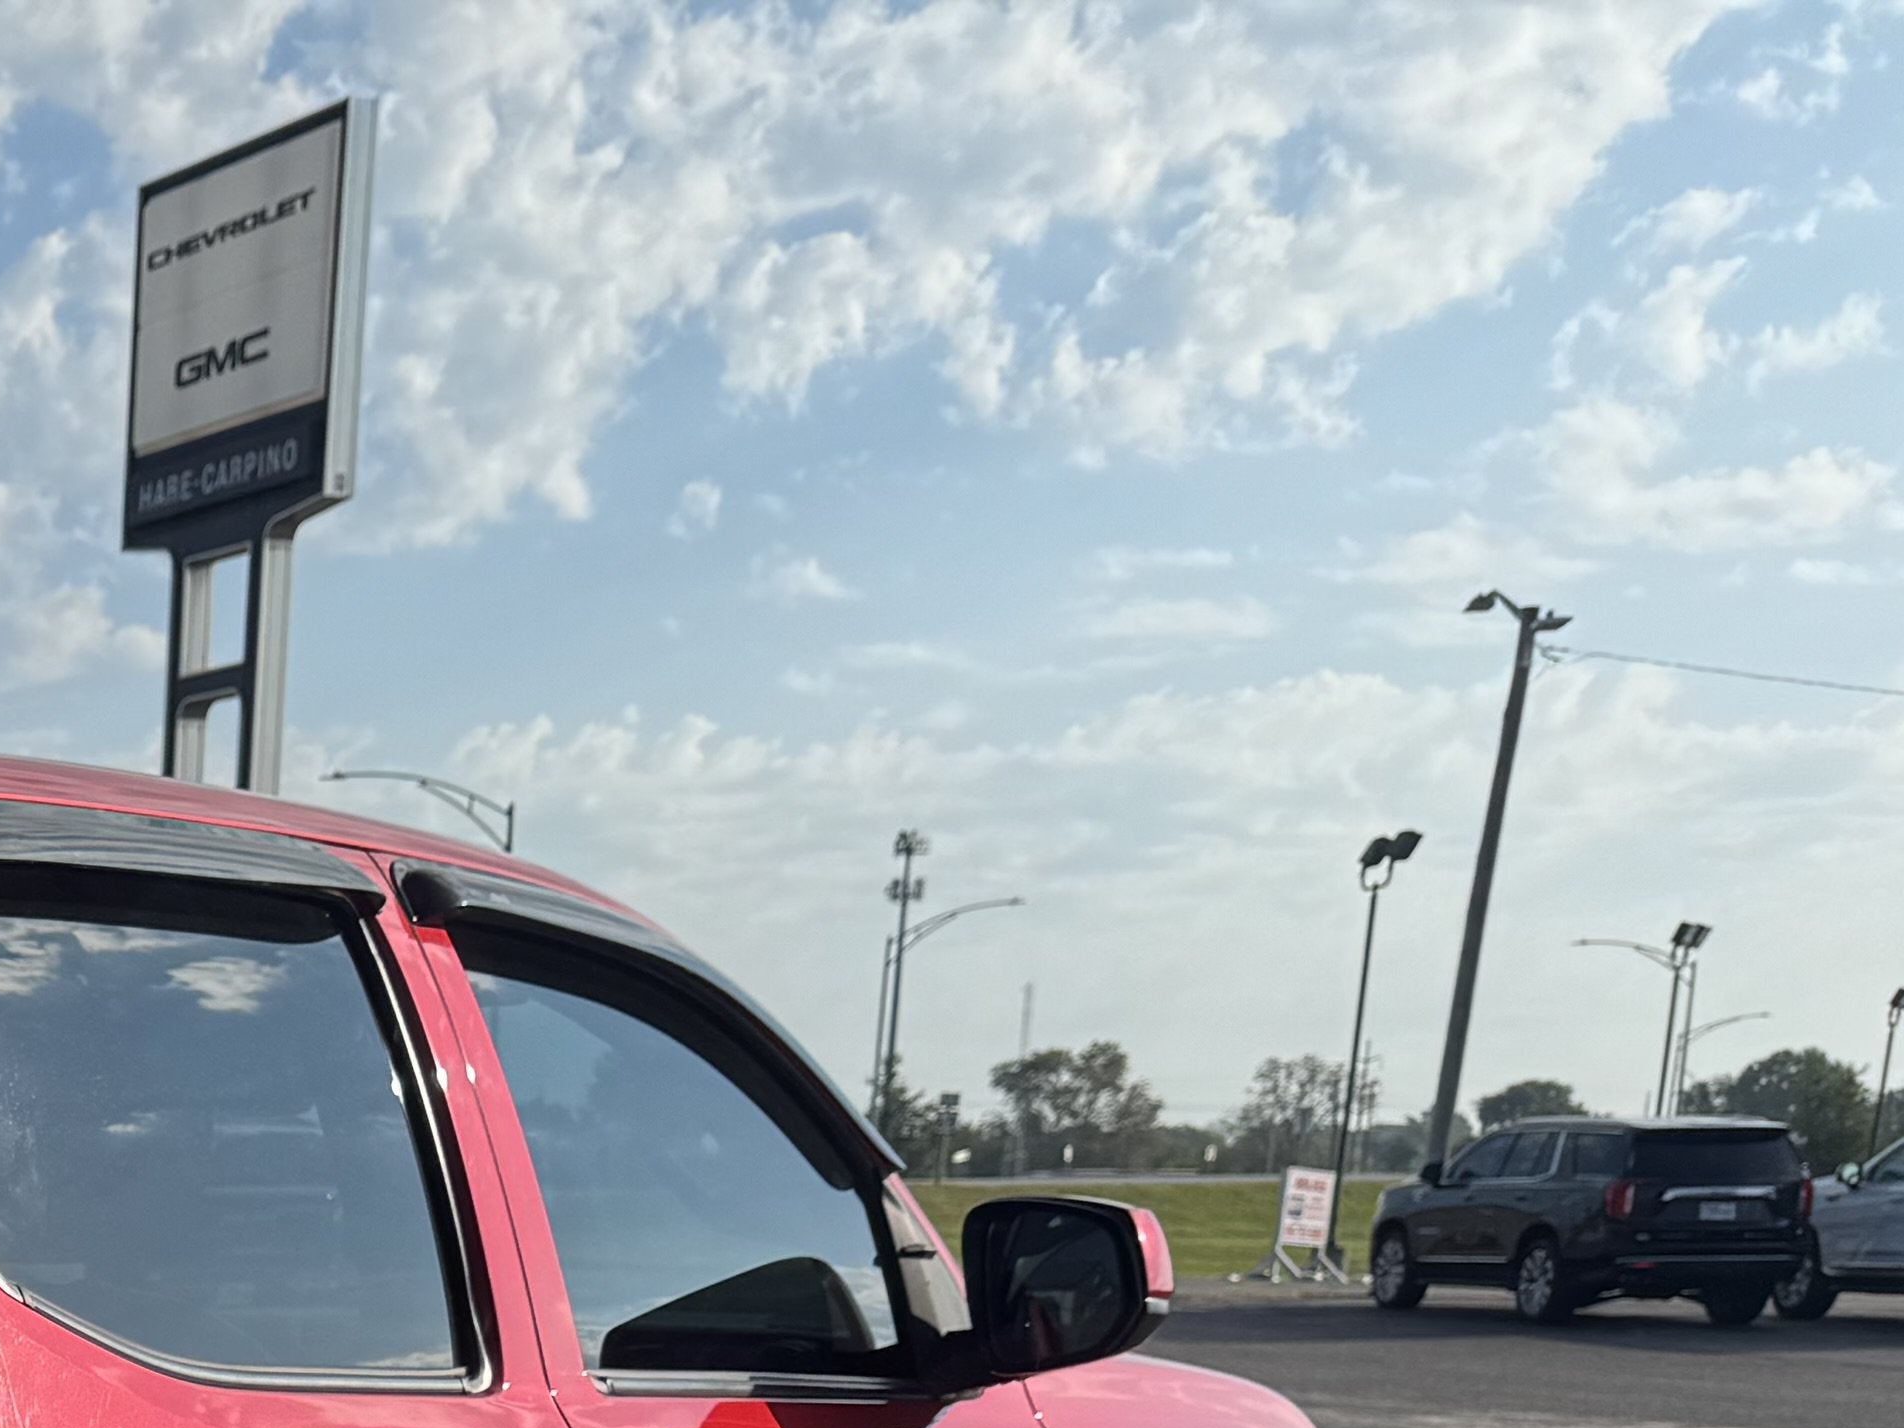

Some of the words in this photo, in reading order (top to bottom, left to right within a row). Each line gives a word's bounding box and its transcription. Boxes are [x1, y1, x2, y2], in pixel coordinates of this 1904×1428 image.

[147, 187, 316, 272] CHEVROLET
[174, 326, 271, 390] GMC
[138, 438, 299, 512] HARE-CARPINO
